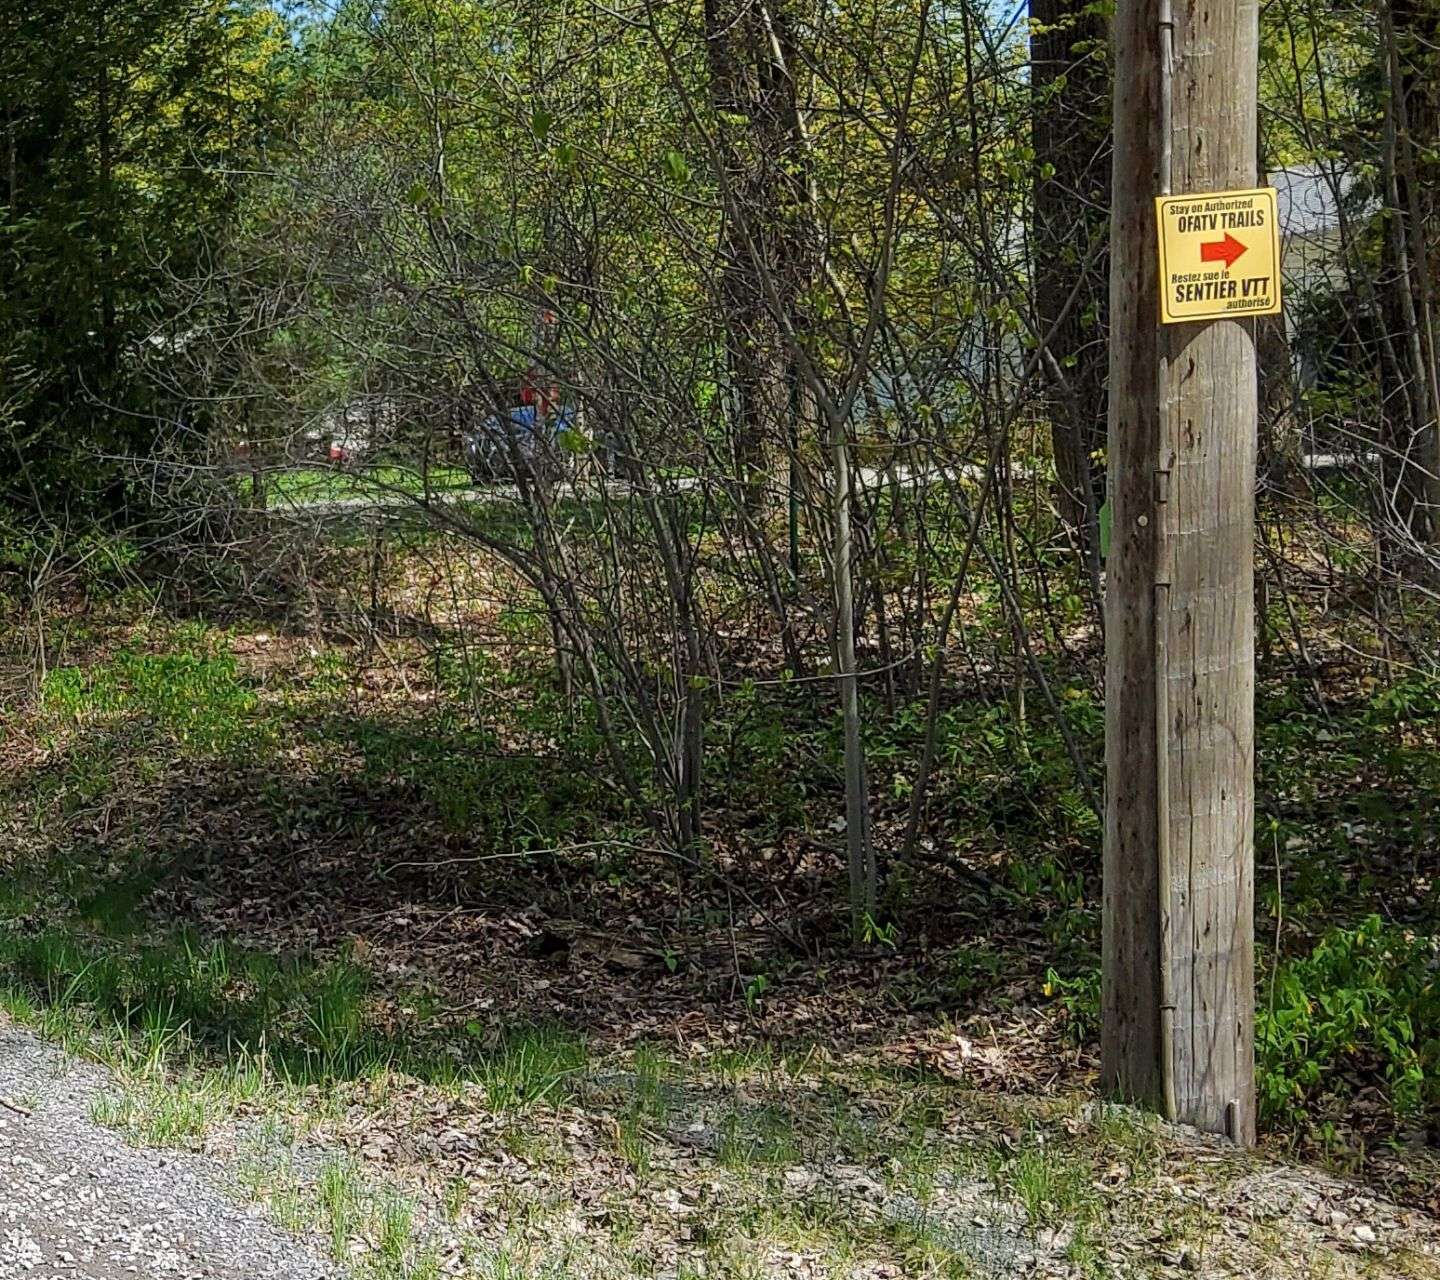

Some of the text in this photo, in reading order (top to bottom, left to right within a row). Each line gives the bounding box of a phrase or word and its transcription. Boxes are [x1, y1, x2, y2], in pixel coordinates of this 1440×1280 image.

[1170, 198, 1253, 215] Stay on Authorized
[1178, 209, 1264, 233] OFATV TRAILS
[1171, 273, 1201, 284] Restez
[1221, 270, 1230, 280] le
[1175, 277, 1270, 303] SENTIER VTT
